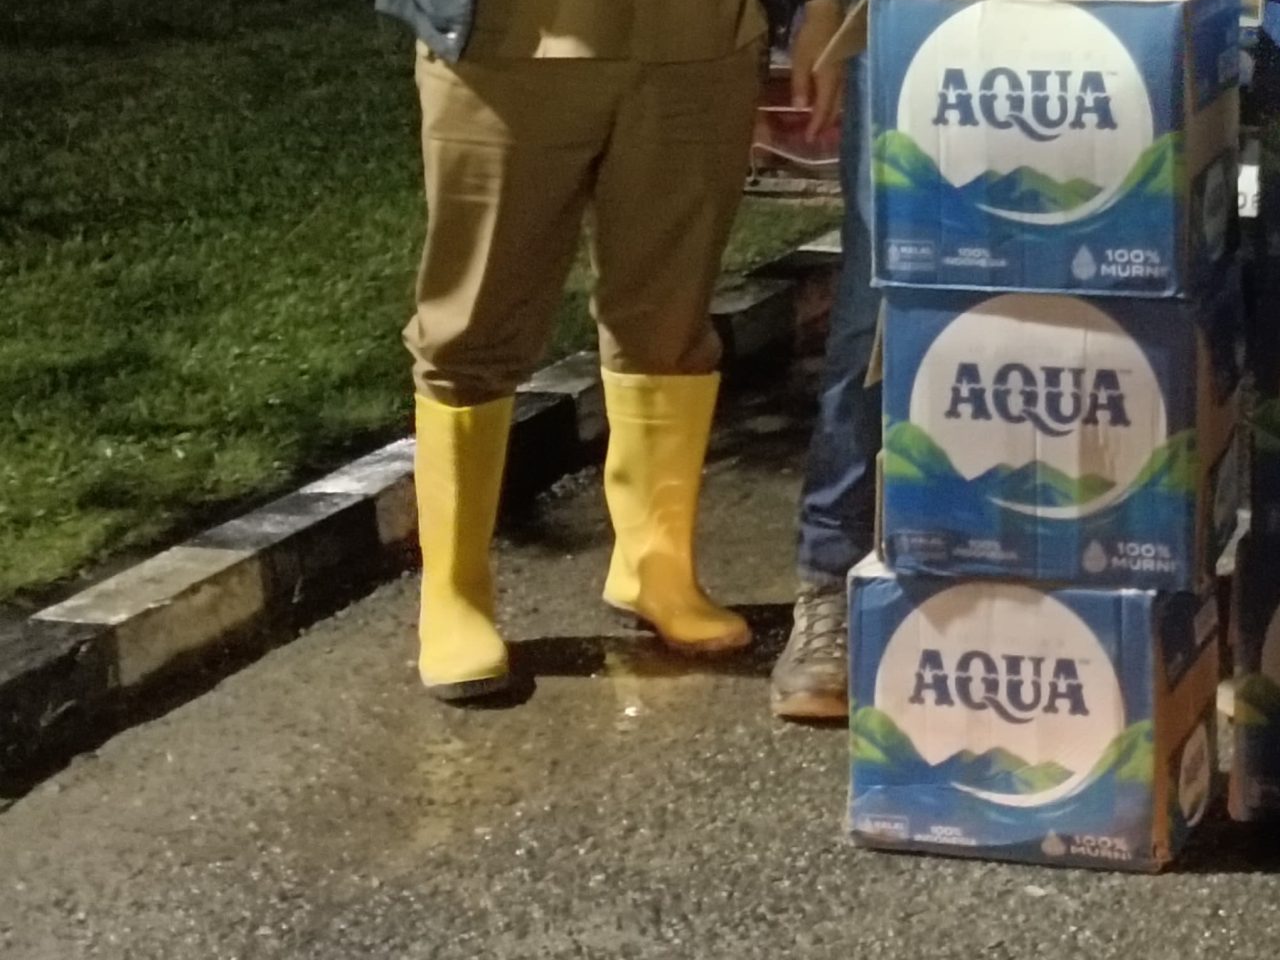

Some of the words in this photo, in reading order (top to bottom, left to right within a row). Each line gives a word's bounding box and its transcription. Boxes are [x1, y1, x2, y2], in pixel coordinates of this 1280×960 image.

[932, 66, 1118, 141] AQUA
[1104, 248, 1160, 264] 100%
[944, 362, 1131, 438] AQUA
[1111, 558, 1178, 573] MURNI
[1117, 543, 1171, 558] 100%
[908, 648, 1089, 724] AQUA
